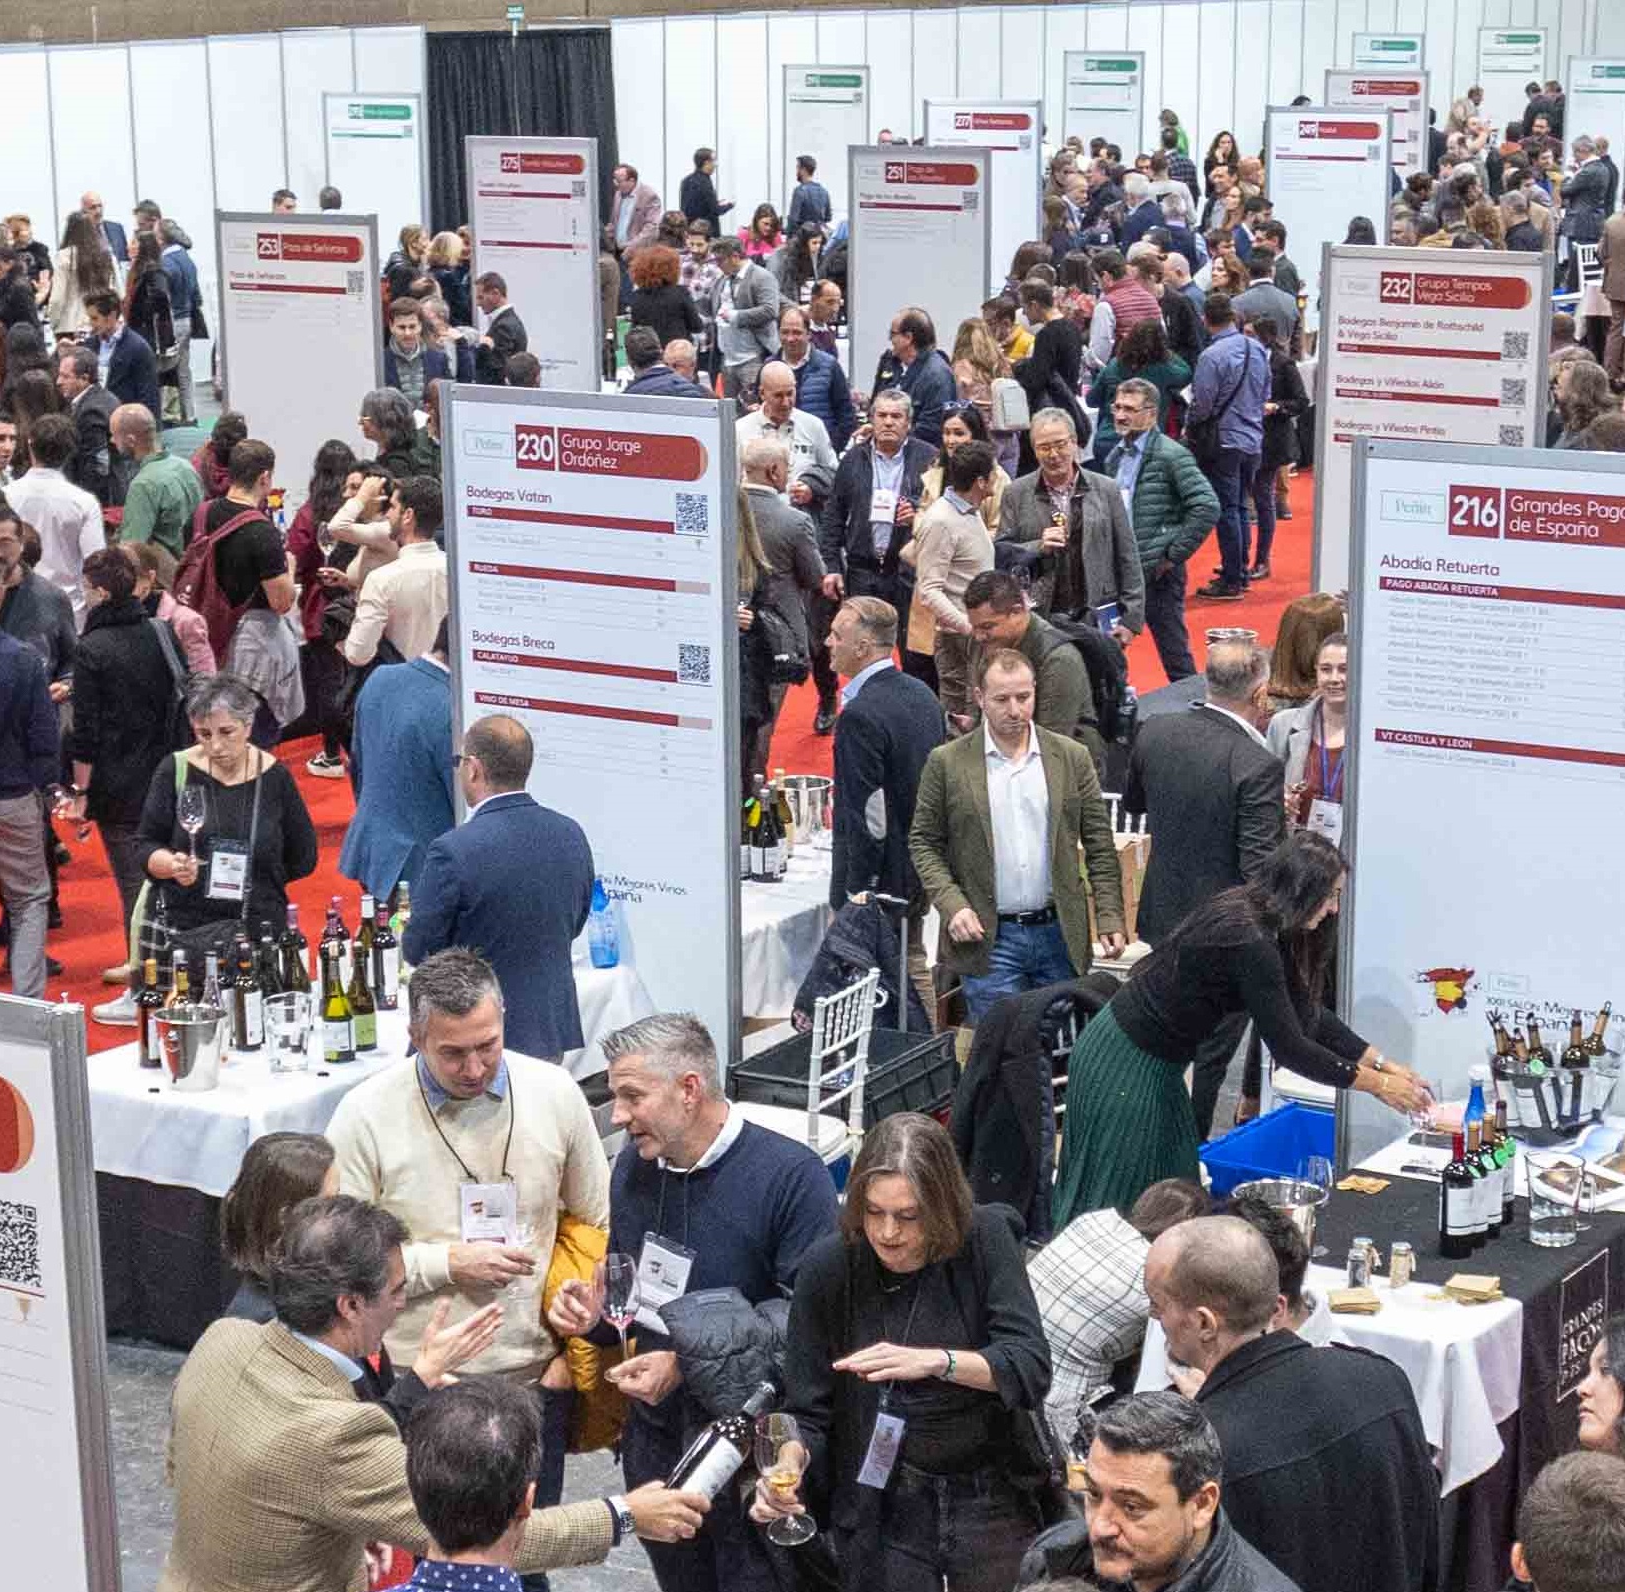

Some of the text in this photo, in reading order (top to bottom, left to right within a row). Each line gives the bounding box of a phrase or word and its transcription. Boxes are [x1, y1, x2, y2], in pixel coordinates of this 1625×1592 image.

[259, 238, 278, 255] 253
[1382, 277, 1493, 298] 232 Grupo Tempos
[1417, 288, 1475, 302] Vega Sicilia
[1338, 316, 1378, 328] Bodegas
[1423, 320, 1434, 329] de
[1336, 375, 1374, 386] Bodegas
[1334, 420, 1373, 431] Bodegas
[518, 433, 641, 461] 230 Grupo Jorge
[562, 450, 618, 470] Ordóñez
[467, 485, 552, 504] Bodegas Vatan
[1452, 494, 1499, 528] 216
[1510, 495, 1582, 517] Grandes
[1509, 516, 1599, 538] de España
[1380, 554, 1500, 577] Abadía Retuerta
[1386, 578, 1498, 597] PAGO ABADÍA RETUERTA
[472, 629, 556, 650] Bodegas Breca
[1395, 732, 1437, 746] CASTILLA
